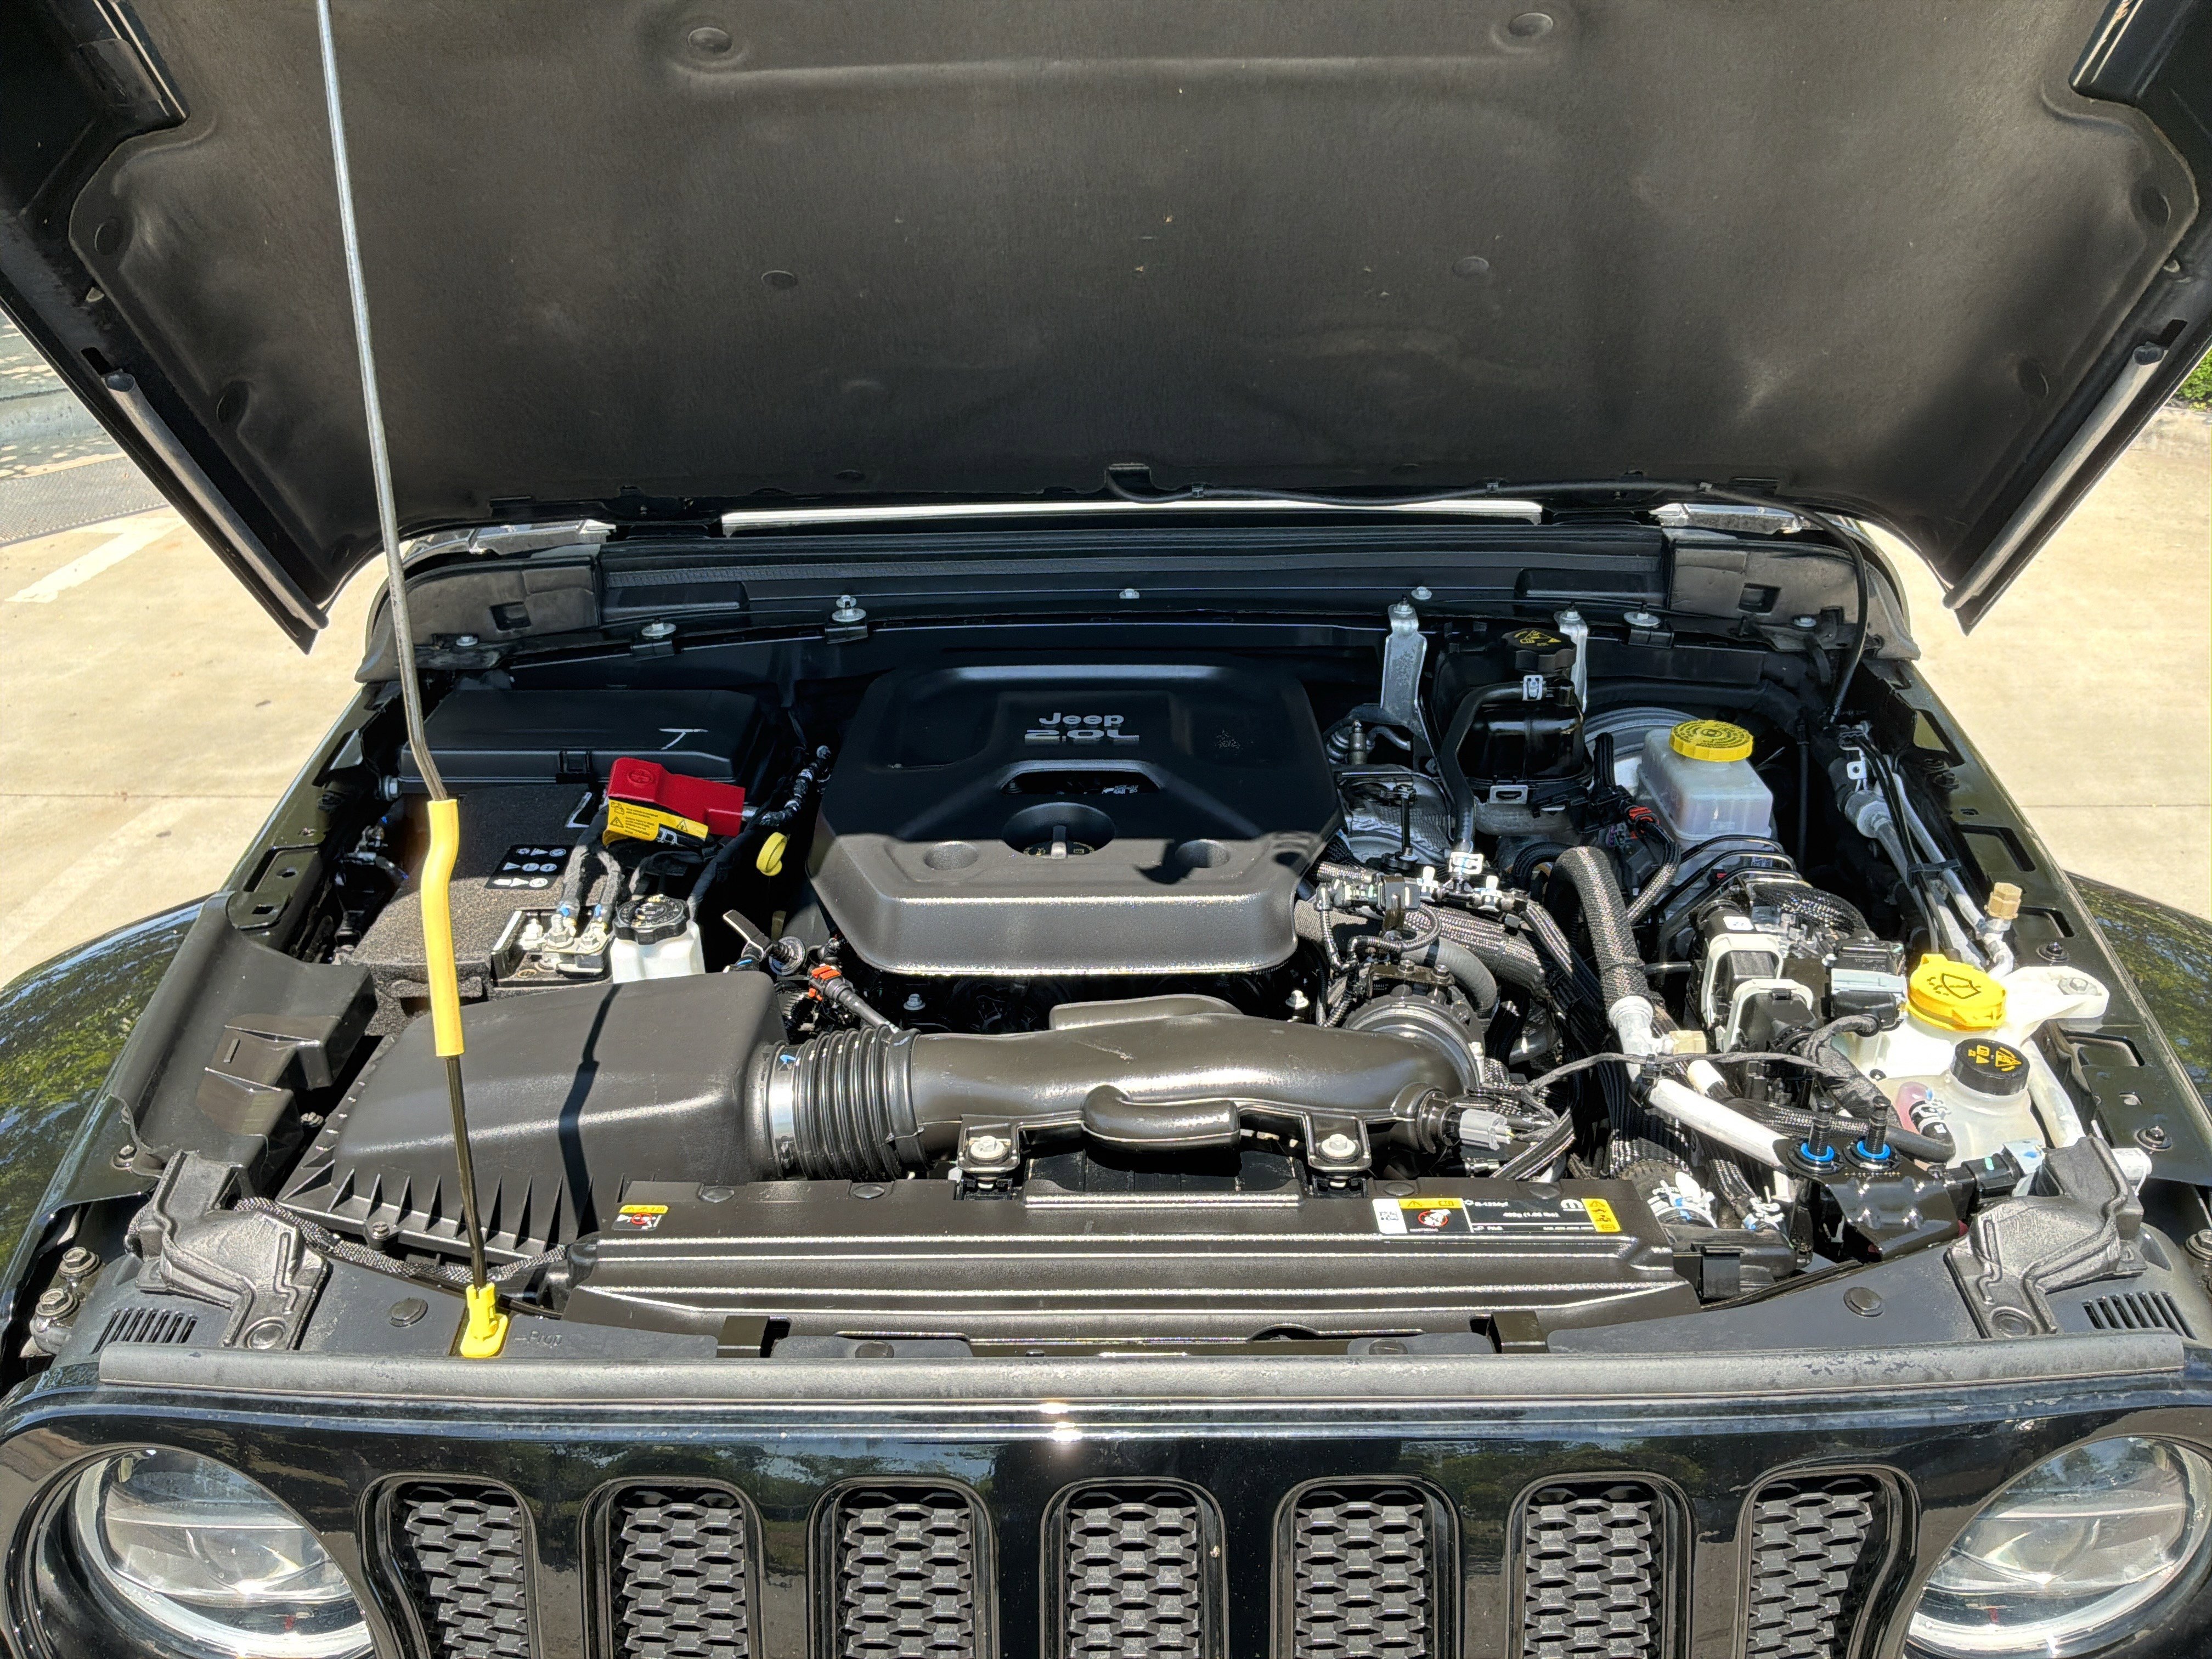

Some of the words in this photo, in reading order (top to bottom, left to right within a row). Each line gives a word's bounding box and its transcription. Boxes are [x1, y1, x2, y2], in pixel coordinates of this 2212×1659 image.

[1039, 712, 1125, 727] Jeep
[1024, 729, 1140, 742] 2.0L
[528, 1330, 562, 1349] Prop
